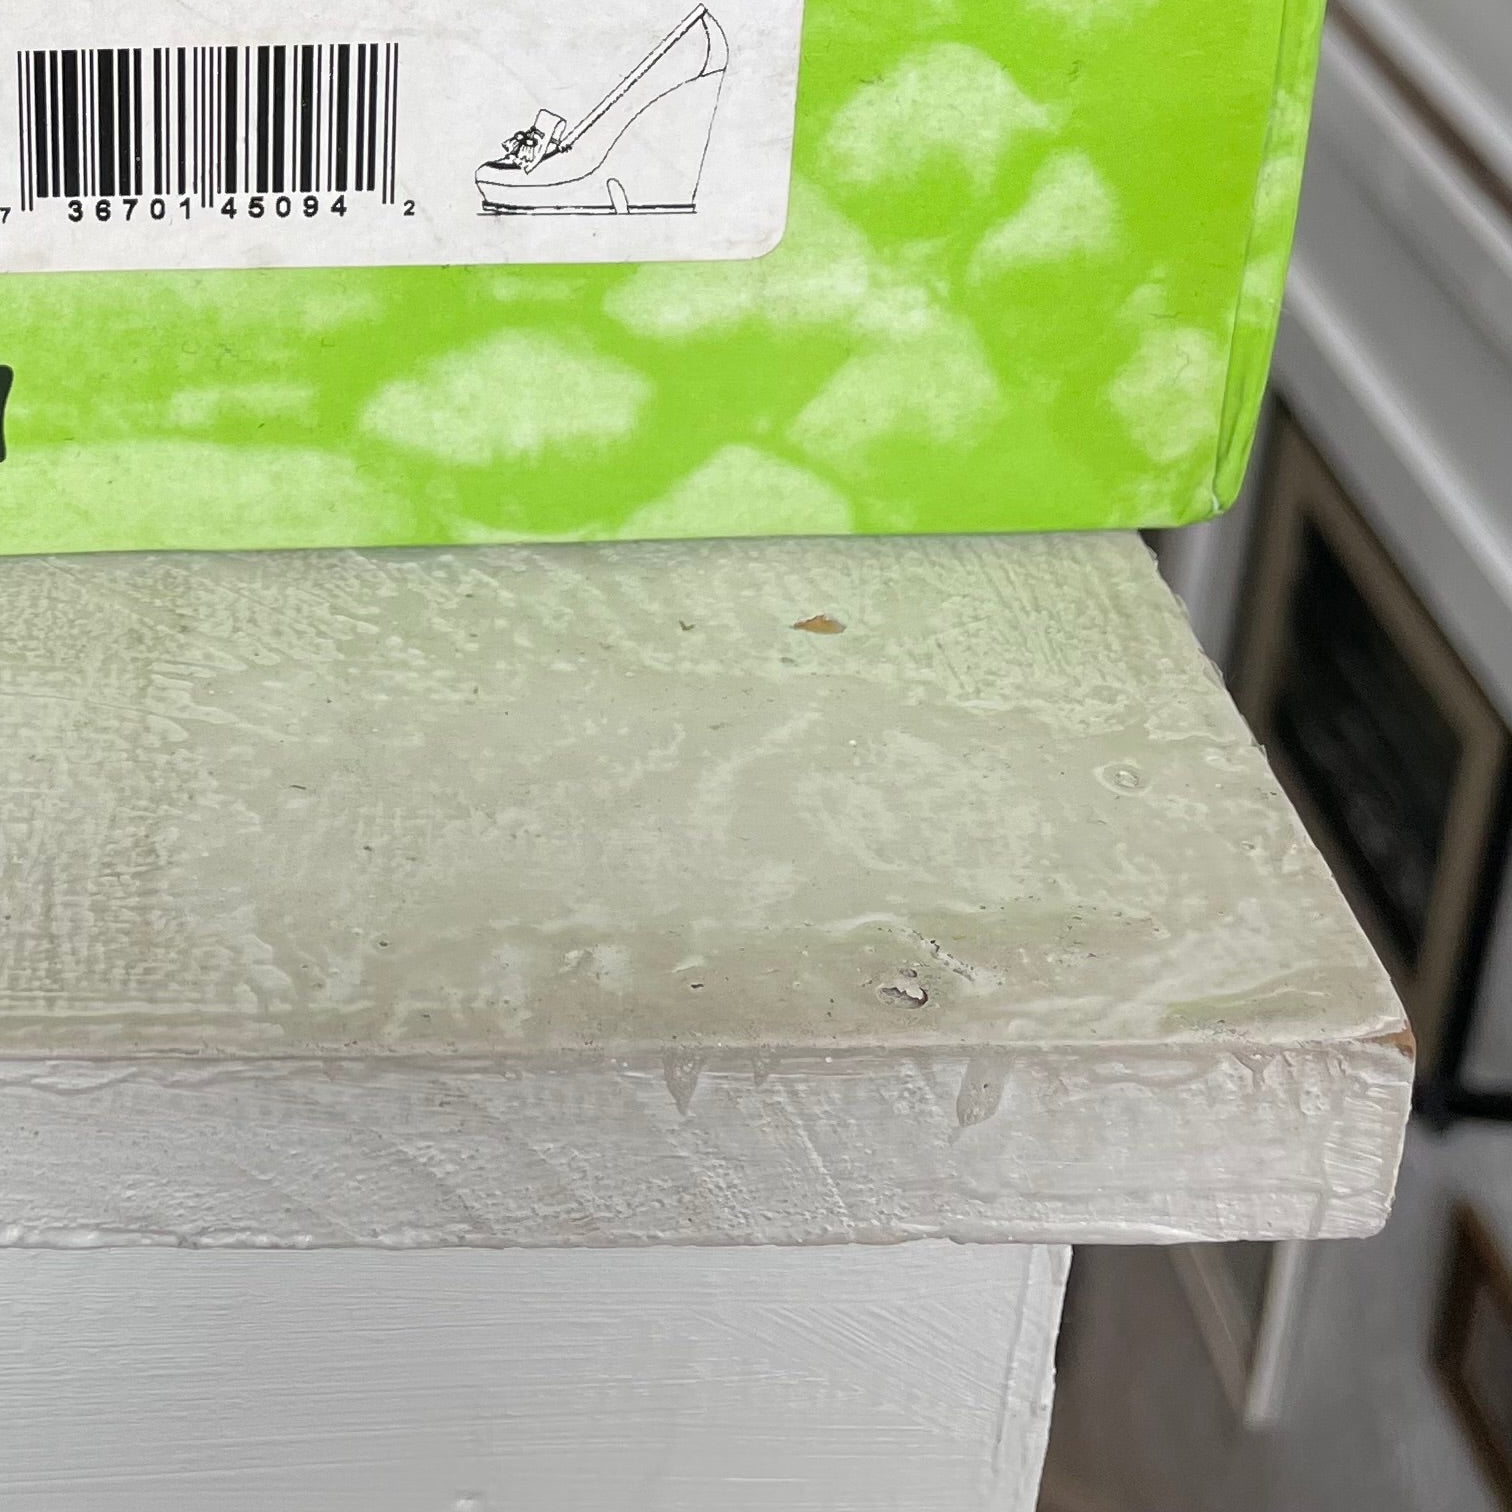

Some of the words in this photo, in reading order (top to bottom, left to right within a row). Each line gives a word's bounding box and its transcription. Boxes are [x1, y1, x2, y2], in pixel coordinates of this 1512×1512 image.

[0, 207, 11, 224] 7
[68, 197, 191, 223] 36701
[220, 194, 347, 219] 45094
[403, 199, 415, 217] 2
